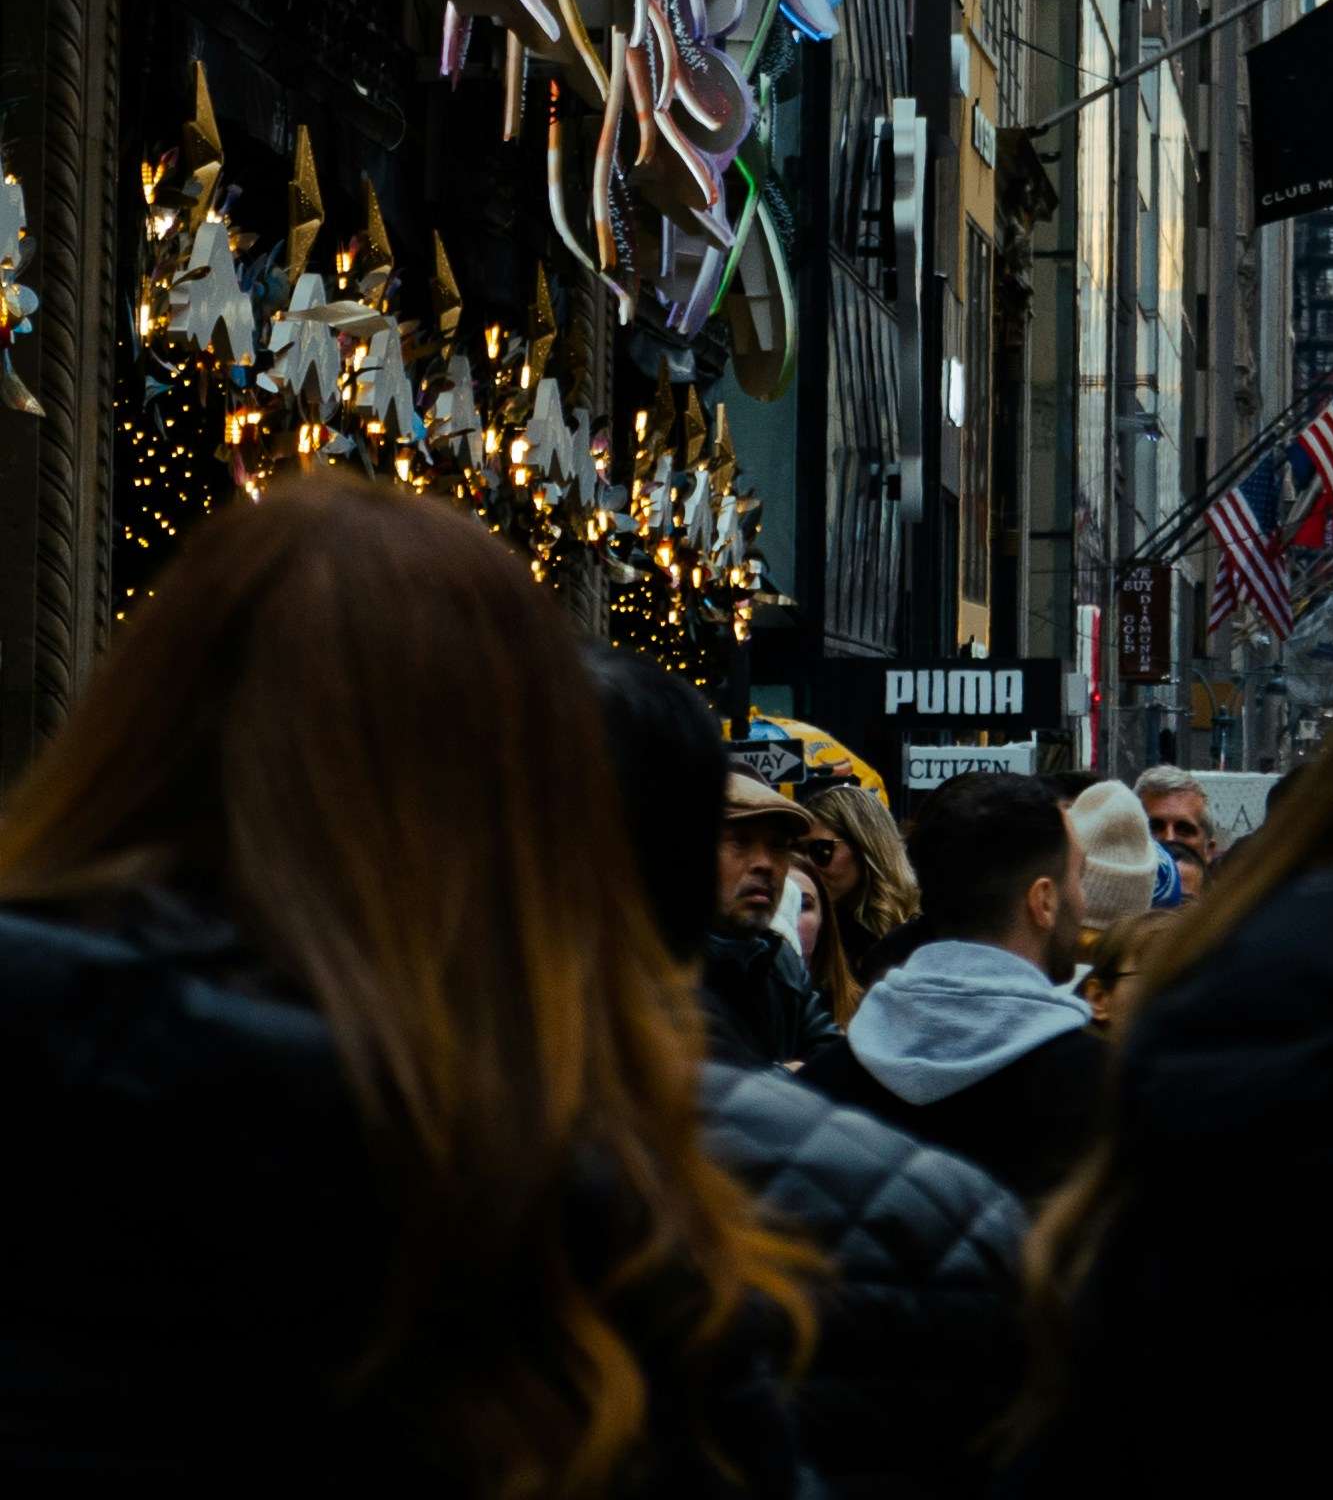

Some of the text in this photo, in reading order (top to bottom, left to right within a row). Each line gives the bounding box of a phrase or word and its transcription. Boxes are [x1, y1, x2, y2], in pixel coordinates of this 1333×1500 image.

[1261, 182, 1313, 206] CLUB
[885, 670, 1023, 714] PUMA
[908, 759, 1010, 780] CITIZEN
